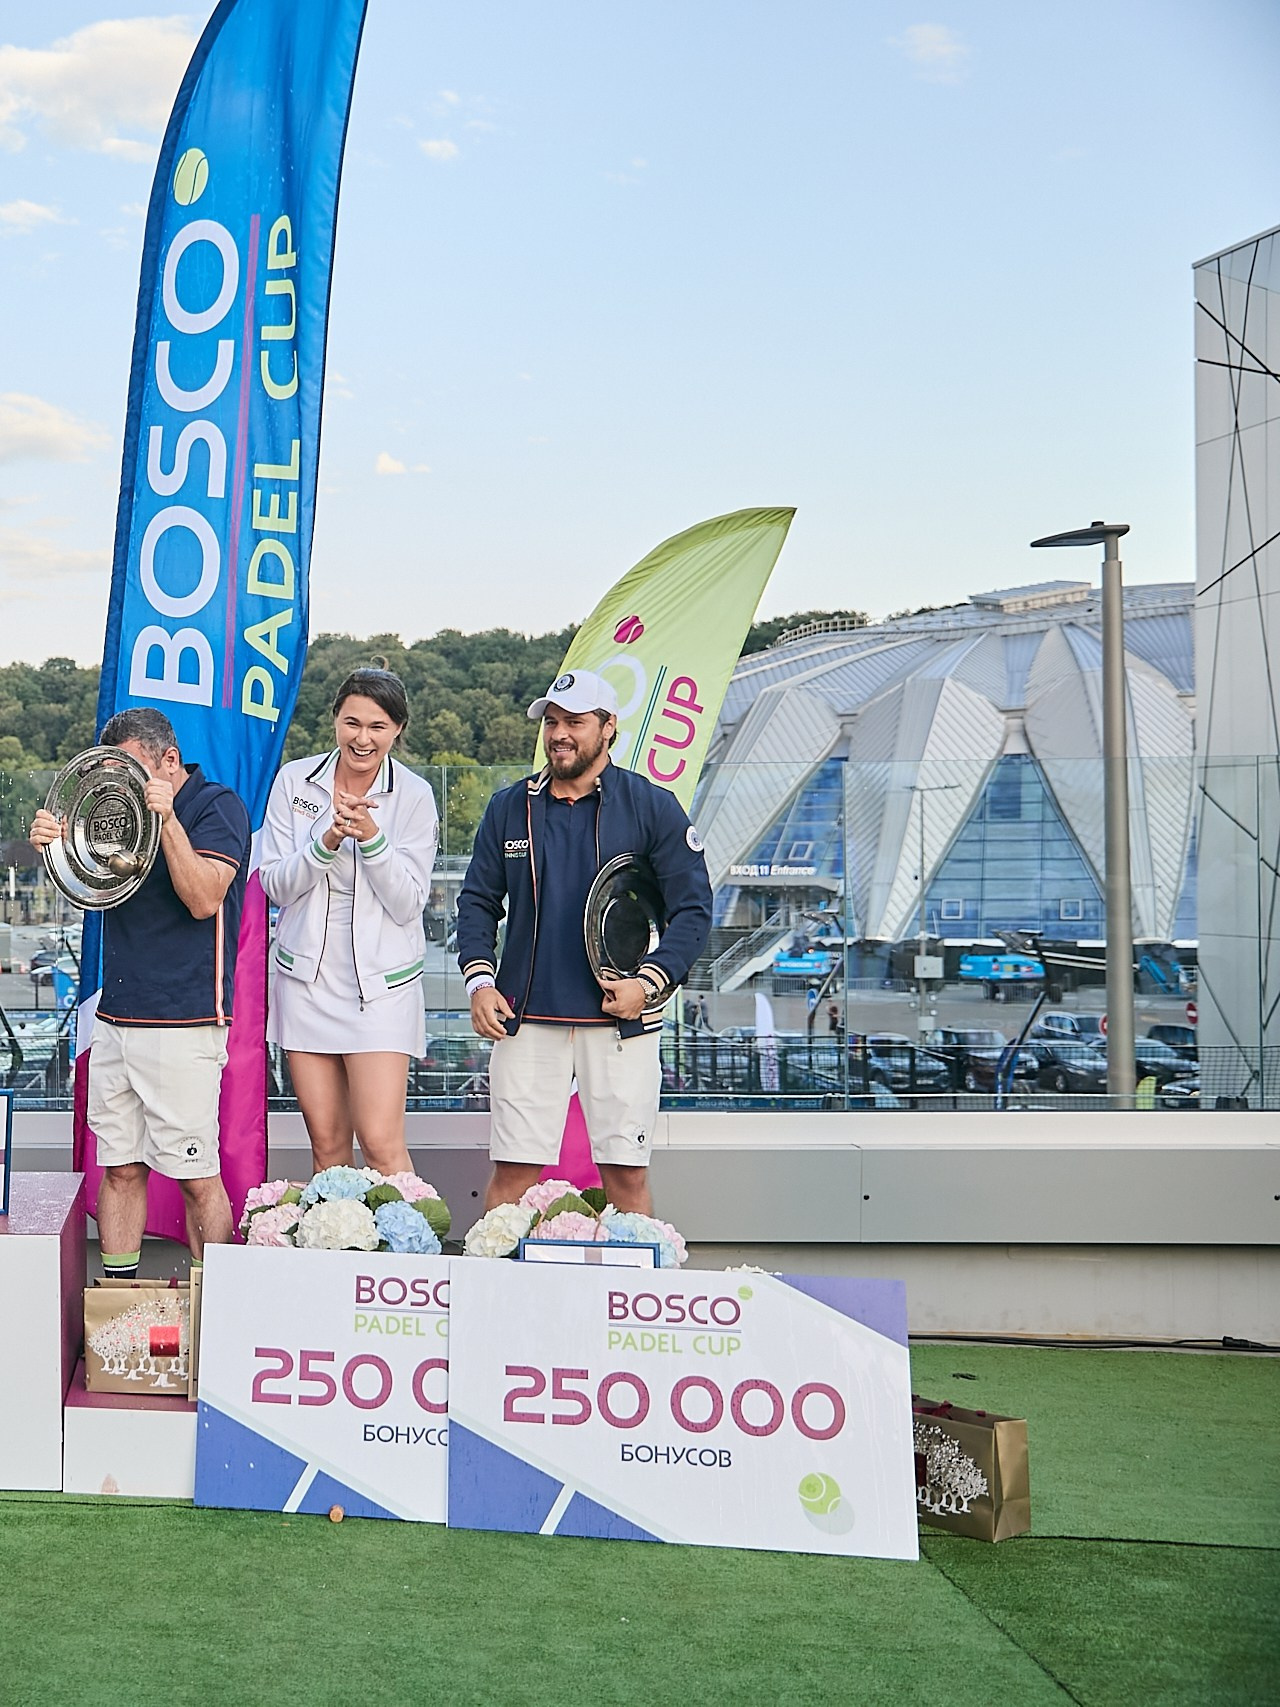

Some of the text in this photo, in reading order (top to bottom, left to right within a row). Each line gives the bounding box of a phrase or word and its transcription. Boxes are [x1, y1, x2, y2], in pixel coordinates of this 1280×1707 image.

[129, 218, 239, 708] BOSCO
[242, 214, 300, 722] PADEL CUP
[647, 676, 704, 782] CUP
[292, 796, 319, 813] BOSCO
[93, 816, 128, 832] BOSCO
[94, 832, 114, 842] PADEL
[504, 839, 529, 850] OSCO
[729, 864, 817, 877] ВХОД 11 Entrance
[608, 1291, 741, 1326] BOSCO
[354, 1313, 426, 1336] PADEL
[607, 1331, 741, 1356] PADEL CUP
[251, 1346, 393, 1411] 250
[503, 1364, 650, 1430] 250
[670, 1375, 846, 1441] 000
[620, 1443, 733, 1469] БОНУСОВ
